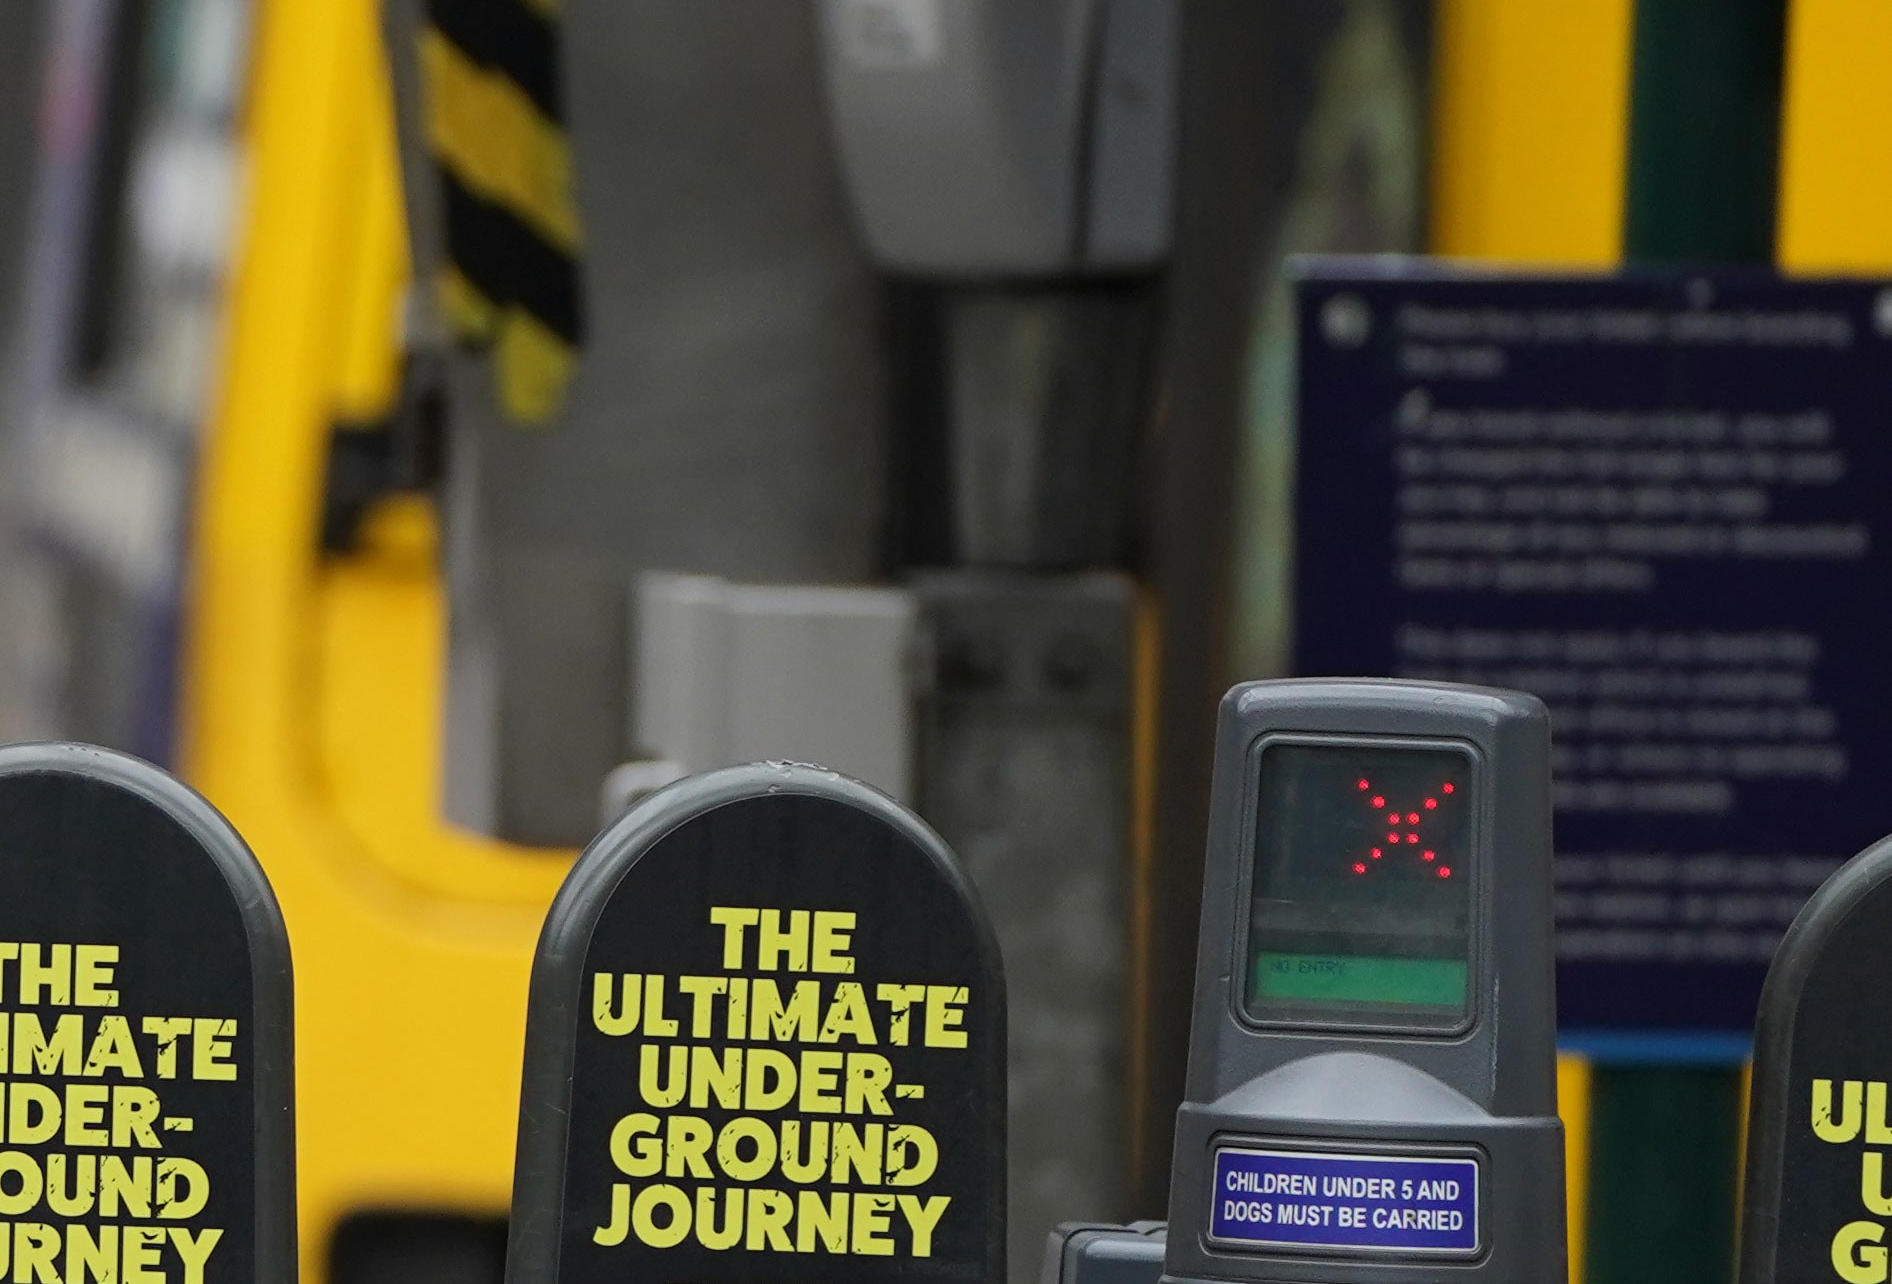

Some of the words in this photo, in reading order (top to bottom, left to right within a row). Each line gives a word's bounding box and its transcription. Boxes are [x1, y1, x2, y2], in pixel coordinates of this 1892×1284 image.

[711, 907, 856, 973] THE
[593, 974, 969, 1048] ULTIMATE
[640, 1046, 924, 1115] UNDER-
[610, 1113, 938, 1185] GROUND
[1224, 1200, 1273, 1224] DOGS
[1277, 1203, 1333, 1227] MUST
[1338, 1206, 1367, 1228] BE
[1372, 1208, 1463, 1231] CARRIED
[1226, 1170, 1317, 1197] CHILDREN
[1323, 1175, 1396, 1200] UNDER
[1401, 1179, 1413, 1200] 5
[1417, 1179, 1460, 1201] AND
[594, 1184, 951, 1257] JOURNEY
